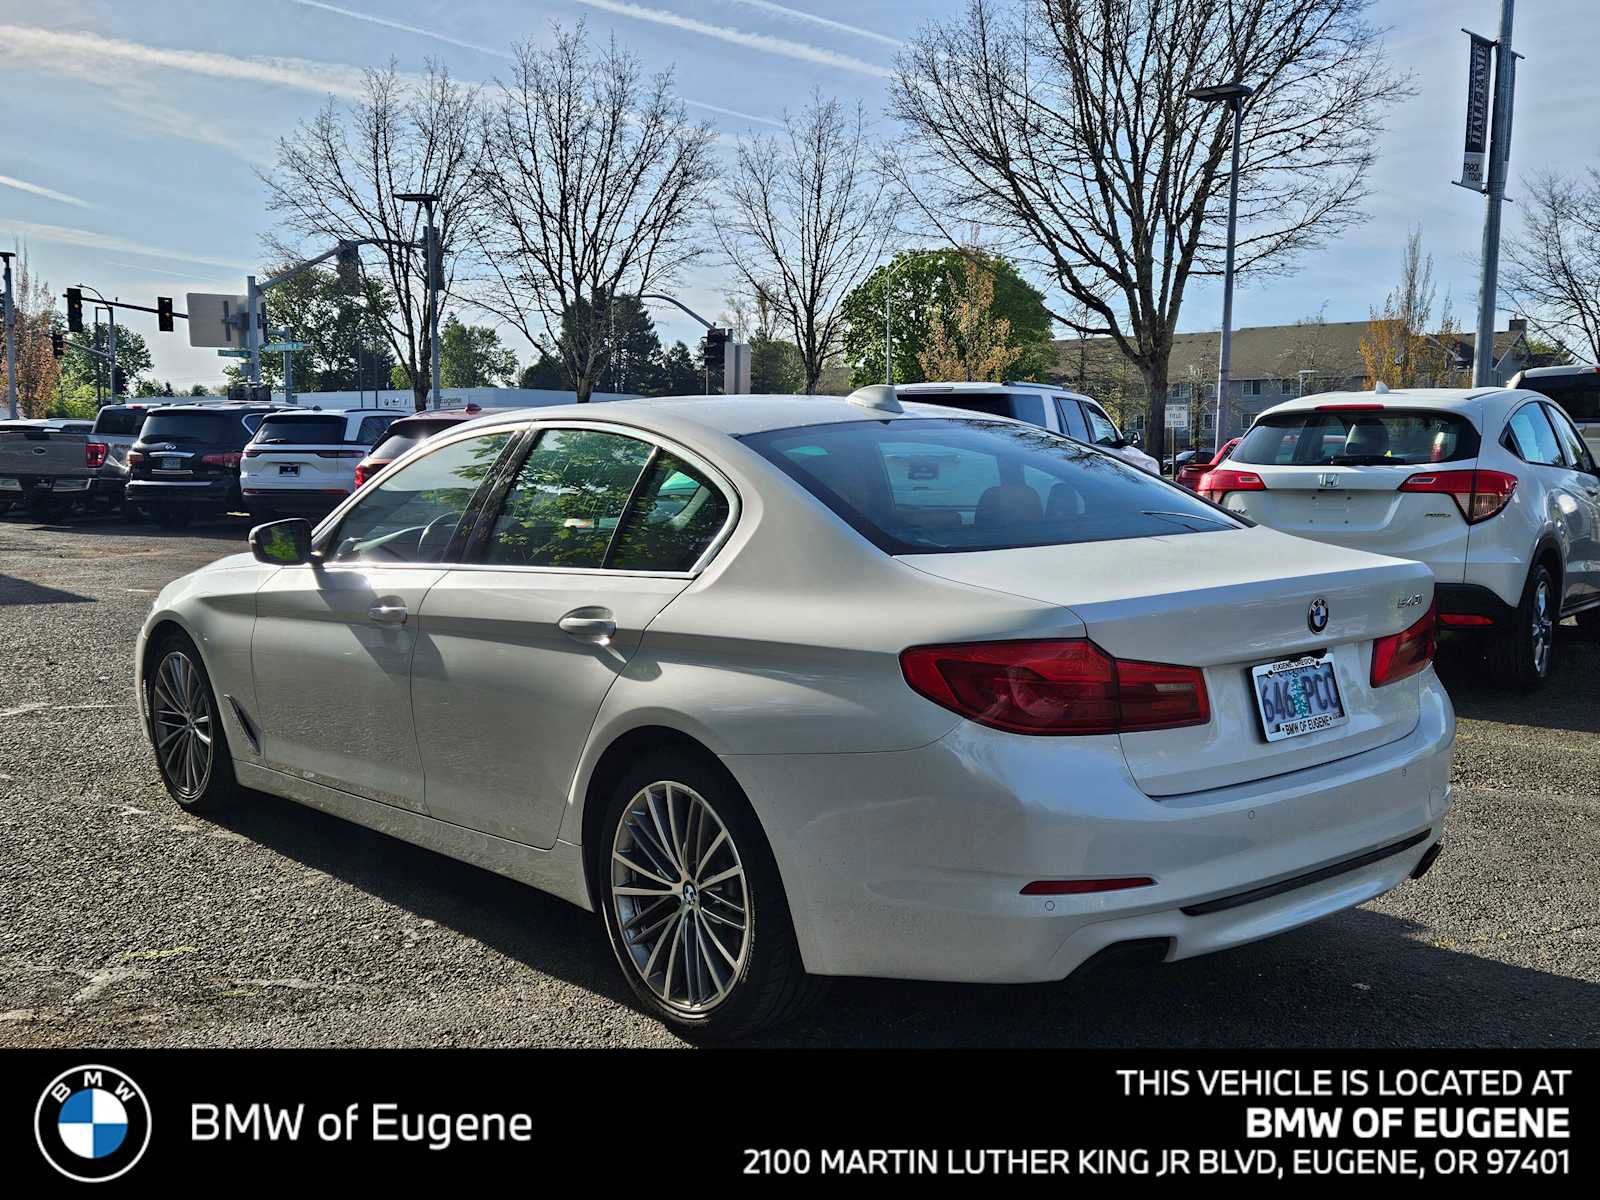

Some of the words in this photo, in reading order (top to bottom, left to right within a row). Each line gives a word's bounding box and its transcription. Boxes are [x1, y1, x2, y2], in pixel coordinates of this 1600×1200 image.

[1262, 680, 1297, 723] 646
[1285, 723, 1299, 736] BMW
[1299, 721, 1308, 732] OF
[1308, 716, 1331, 729] EUGENE
